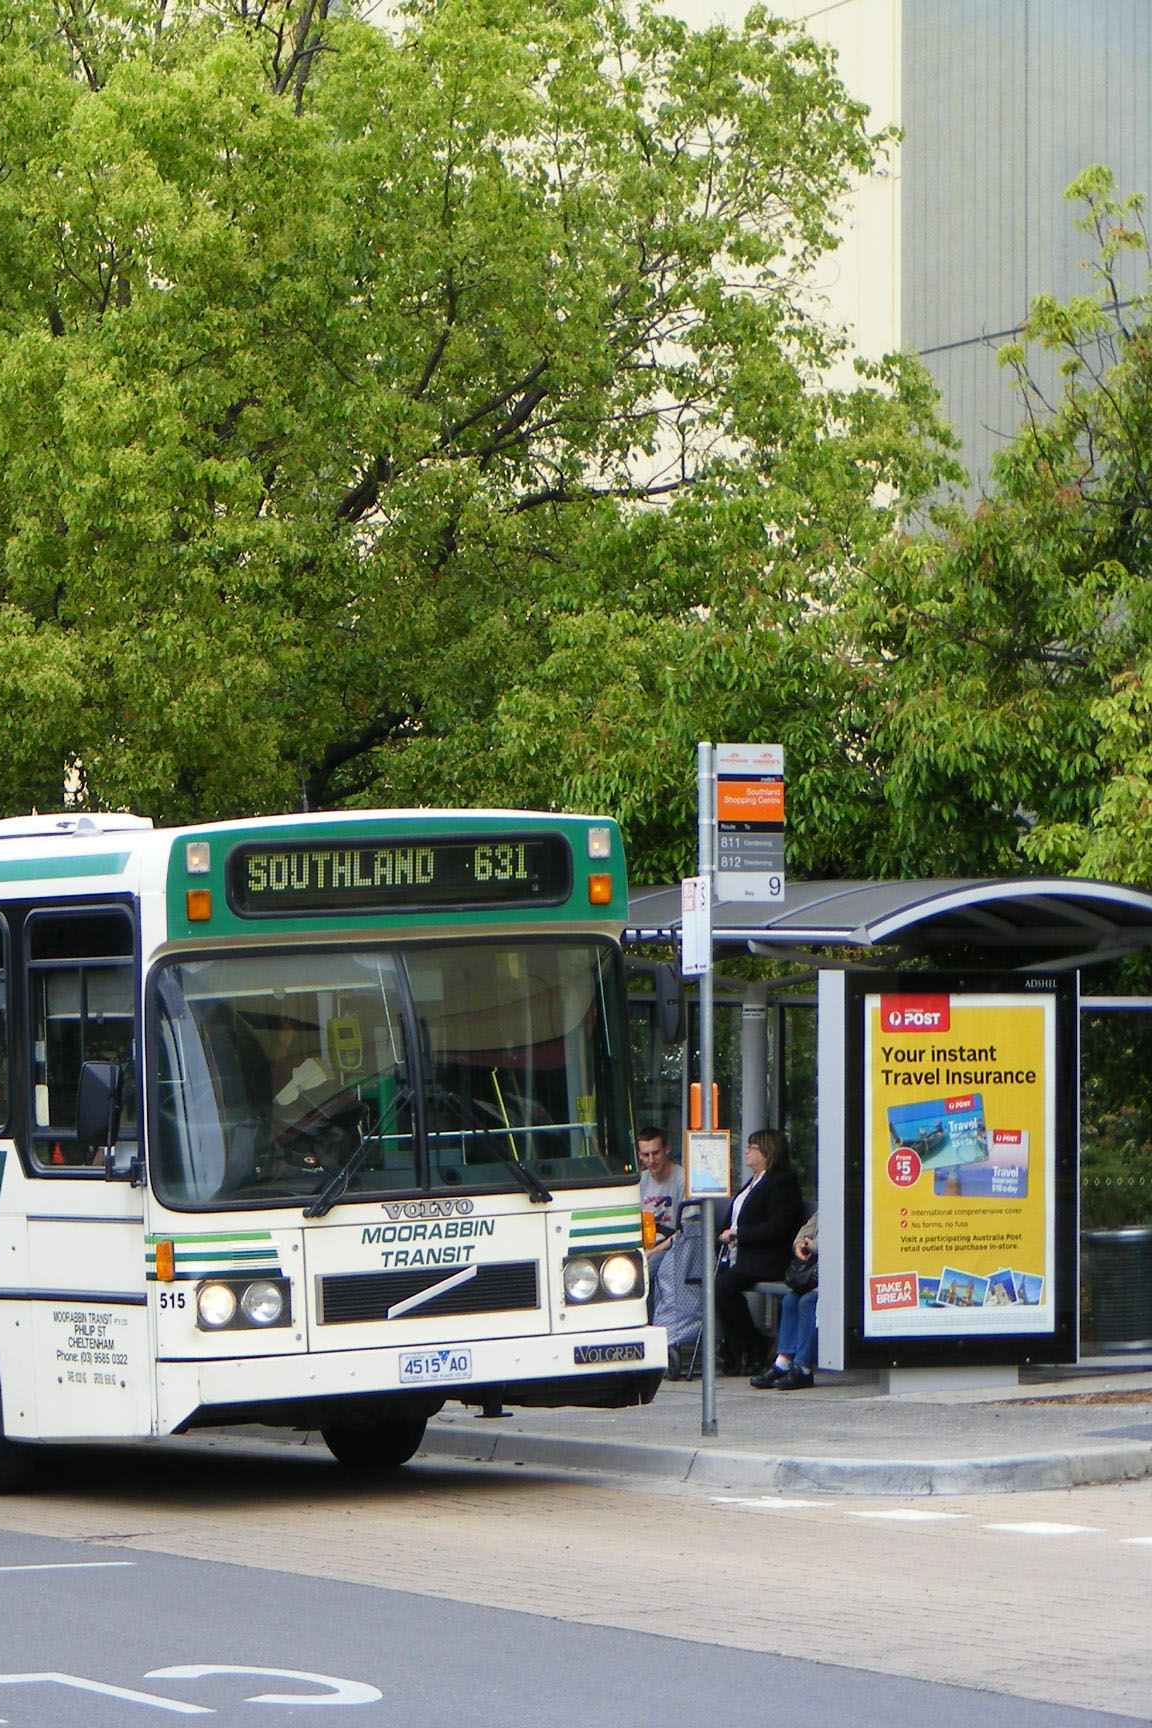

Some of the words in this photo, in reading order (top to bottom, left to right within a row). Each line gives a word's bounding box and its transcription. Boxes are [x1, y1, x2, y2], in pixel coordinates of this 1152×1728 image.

[745, 788, 780, 796] Southland
[723, 795, 756, 806] Shopping
[758, 796, 780, 805] Centre
[721, 836, 740, 848] 811
[248, 848, 434, 891] SOUTHLAND
[474, 843, 528, 881] 631
[721, 856, 741, 868] 812
[769, 876, 781, 896] 9
[1025, 979, 1057, 988] ADSHEL
[904, 1012, 941, 1026] POST
[881, 1046, 926, 1062] Your
[931, 1045, 997, 1062] instant
[881, 1068, 940, 1085] Travel
[945, 1069, 1037, 1085] Insurance
[955, 1100, 971, 1109] POST
[948, 1117, 978, 1132] Travel
[896, 1161, 911, 1175] $5
[992, 1166, 1019, 1177] Travel
[382, 1198, 474, 1220] VOLVO
[911, 1208, 953, 1216] International
[954, 1208, 1003, 1217] comprehensive
[1004, 1207, 1022, 1215] cover
[361, 1219, 495, 1244] MOORABBIN
[911, 1221, 921, 1229] No
[944, 1221, 953, 1229] no
[954, 1220, 968, 1228] fuss
[900, 1235, 917, 1244] Visit
[924, 1234, 971, 1244] participating
[972, 1233, 1005, 1242] Australia
[1005, 1233, 1022, 1241] Post
[900, 1245, 920, 1253] retail
[921, 1244, 944, 1252] outlet
[945, 1244, 953, 1252] to
[954, 1243, 988, 1253] purchase
[381, 1245, 475, 1267] TRANSIT
[875, 1281, 902, 1293] TAKE
[903, 1280, 912, 1291] A
[160, 1292, 185, 1309] 515
[876, 1290, 912, 1304] BREAK
[53, 1311, 88, 1323] MOORABBIN
[88, 1313, 112, 1325] TRANSIT
[74, 1325, 95, 1336] PHILIP
[97, 1325, 106, 1337] ST
[68, 1336, 114, 1350] CHELTENHAM
[56, 1349, 79, 1362] Phone:
[80, 1351, 92, 1366] (03)
[578, 1345, 643, 1362] VOLGREN
[404, 1358, 440, 1375] 4515
[449, 1356, 468, 1372] AO
